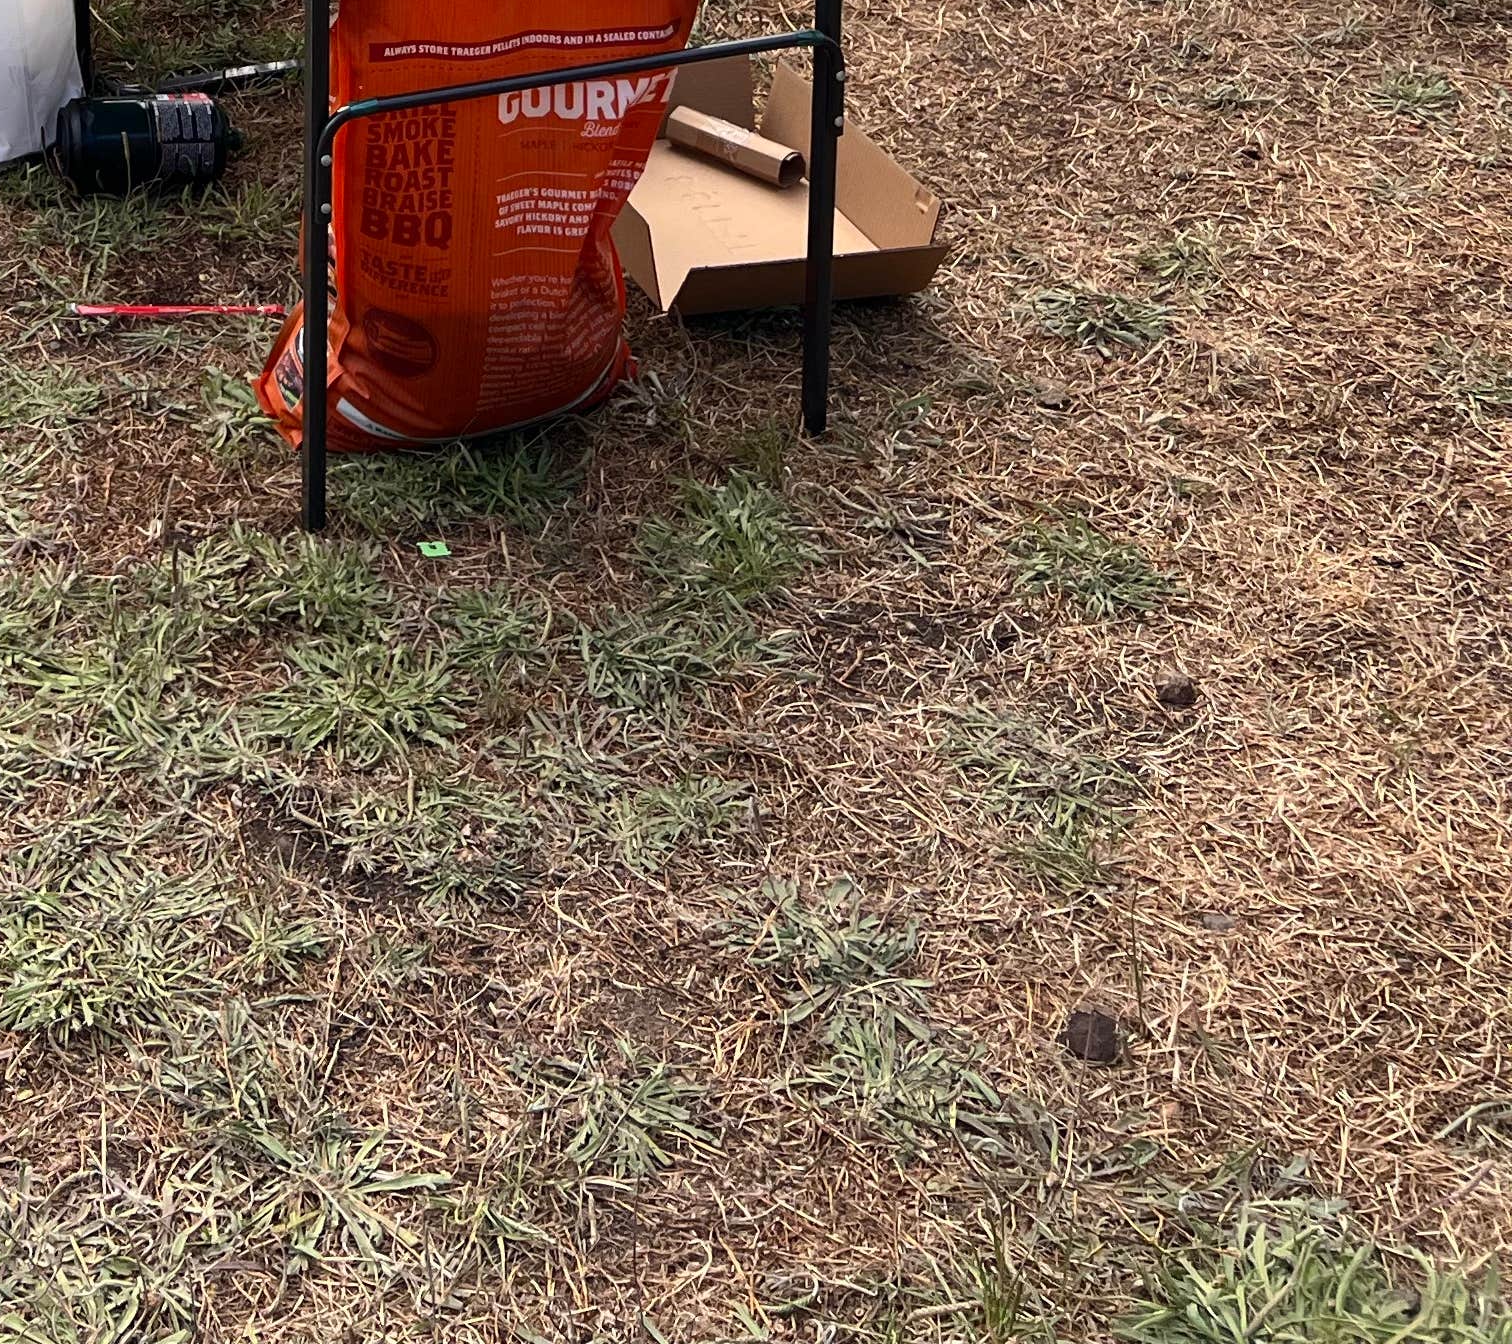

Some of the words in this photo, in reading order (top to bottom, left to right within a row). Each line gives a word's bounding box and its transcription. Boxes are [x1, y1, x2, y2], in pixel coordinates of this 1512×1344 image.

[384, 44, 417, 58] ALWAYS
[418, 44, 449, 56] STORE
[451, 45, 491, 57] TRAEGER
[492, 37, 521, 54] PELLETS
[522, 34, 562, 45] INDOORS
[563, 35, 584, 45] AND
[584, 34, 595, 44] IN
[595, 33, 603, 43] A
[603, 31, 636, 42] SEALED
[497, 67, 679, 125] GOURMET
[367, 117, 457, 145] SMOKE
[580, 121, 620, 138] Blend
[366, 139, 456, 170] BAKE
[365, 166, 454, 192] ROAST
[363, 187, 453, 213] BRAISE
[496, 188, 538, 204] TRAEGER'S
[540, 189, 587, 200] GOURMET
[498, 205, 509, 216] OF
[509, 199, 536, 213] SWEET
[537, 200, 569, 212] MAPLE
[360, 207, 453, 250] BBQ
[494, 214, 523, 229] SAVORY
[525, 212, 567, 224] HICKORY
[568, 215, 590, 225] AND
[516, 225, 551, 236] FLAVOR
[552, 226, 563, 235] IS
[540, 285, 569, 297] Dutch
